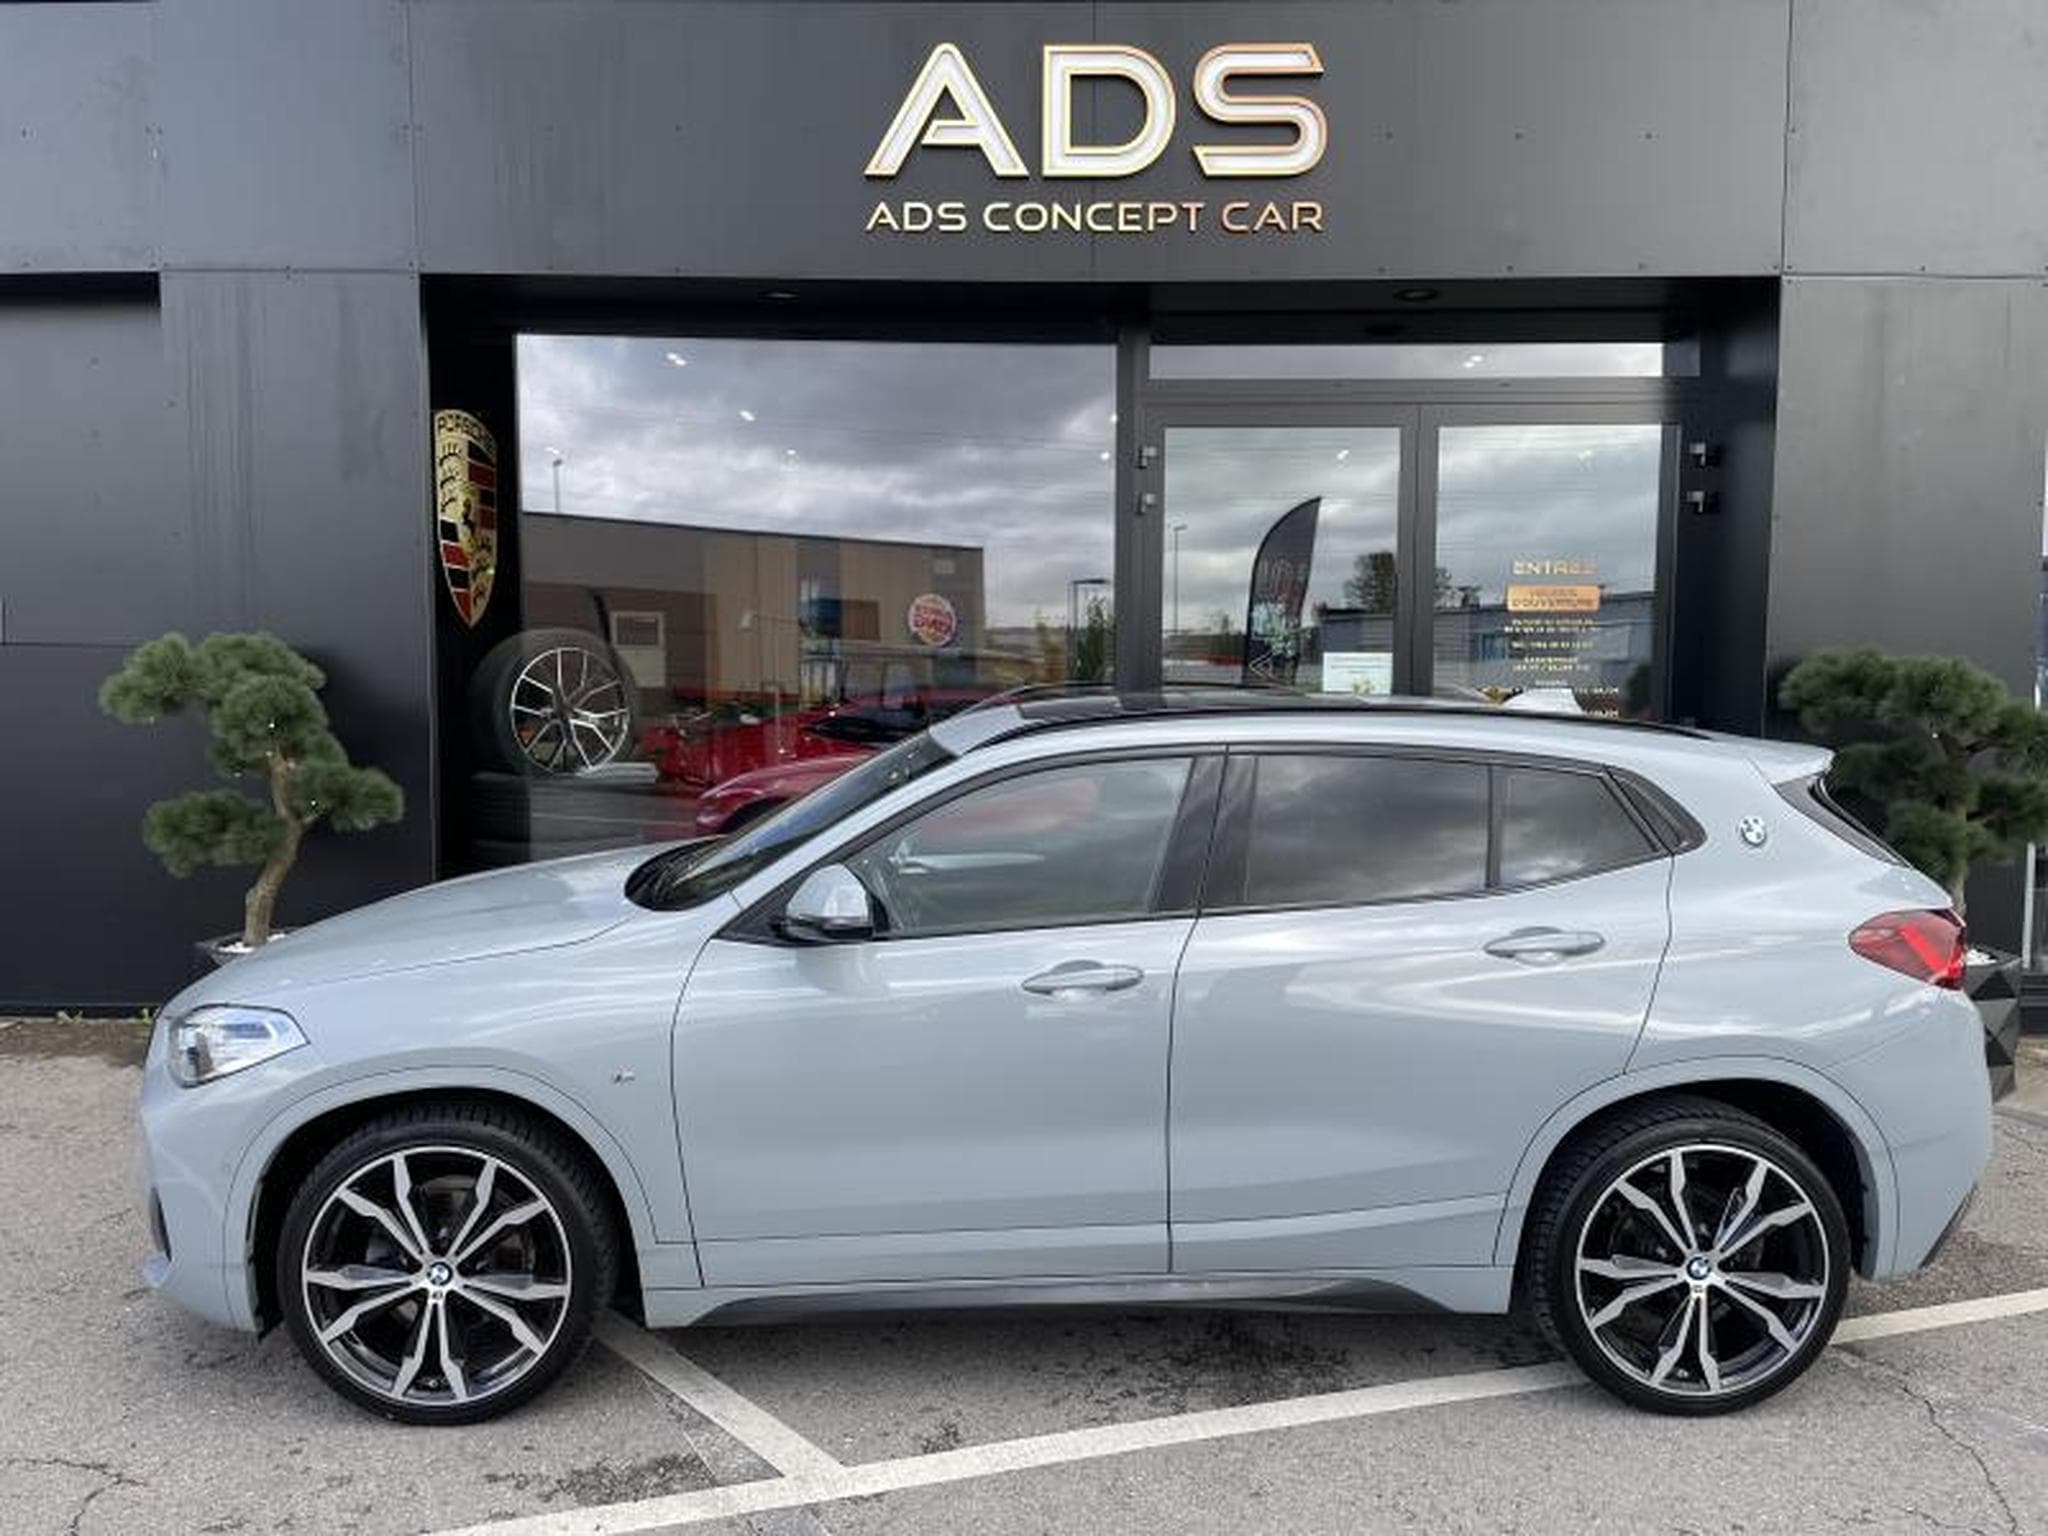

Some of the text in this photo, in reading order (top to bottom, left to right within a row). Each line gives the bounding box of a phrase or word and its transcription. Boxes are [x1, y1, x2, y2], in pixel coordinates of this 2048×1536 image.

[864, 42, 1328, 178] ADS
[865, 202, 1325, 234] ADS CONCEPT CAR
